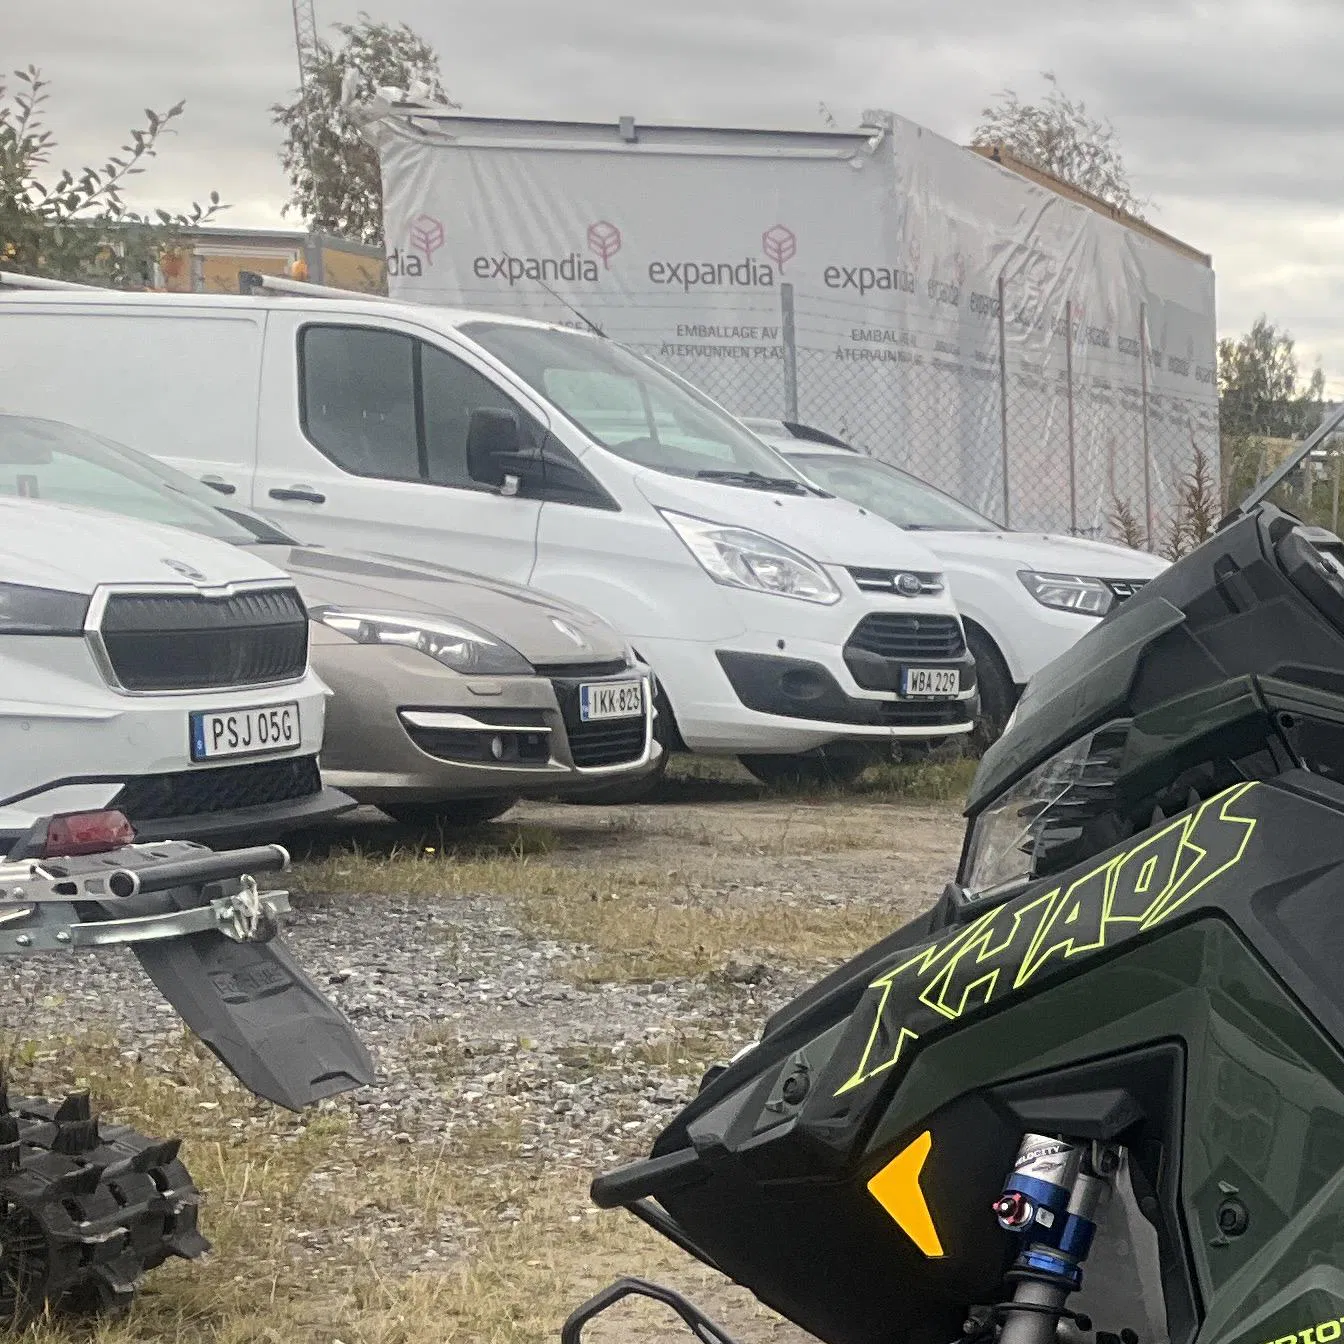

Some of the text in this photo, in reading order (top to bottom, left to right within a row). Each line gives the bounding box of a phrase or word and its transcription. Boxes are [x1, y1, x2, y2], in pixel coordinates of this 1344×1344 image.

[473, 252, 599, 287] expandia
[648, 257, 774, 294] expandia
[676, 324, 779, 340] EMBALLAGE AV
[754, 346, 785, 360] PLAS
[935, 671, 956, 692] 229
[212, 714, 252, 751] PSJ
[833, 781, 1261, 1097] KHAOS
